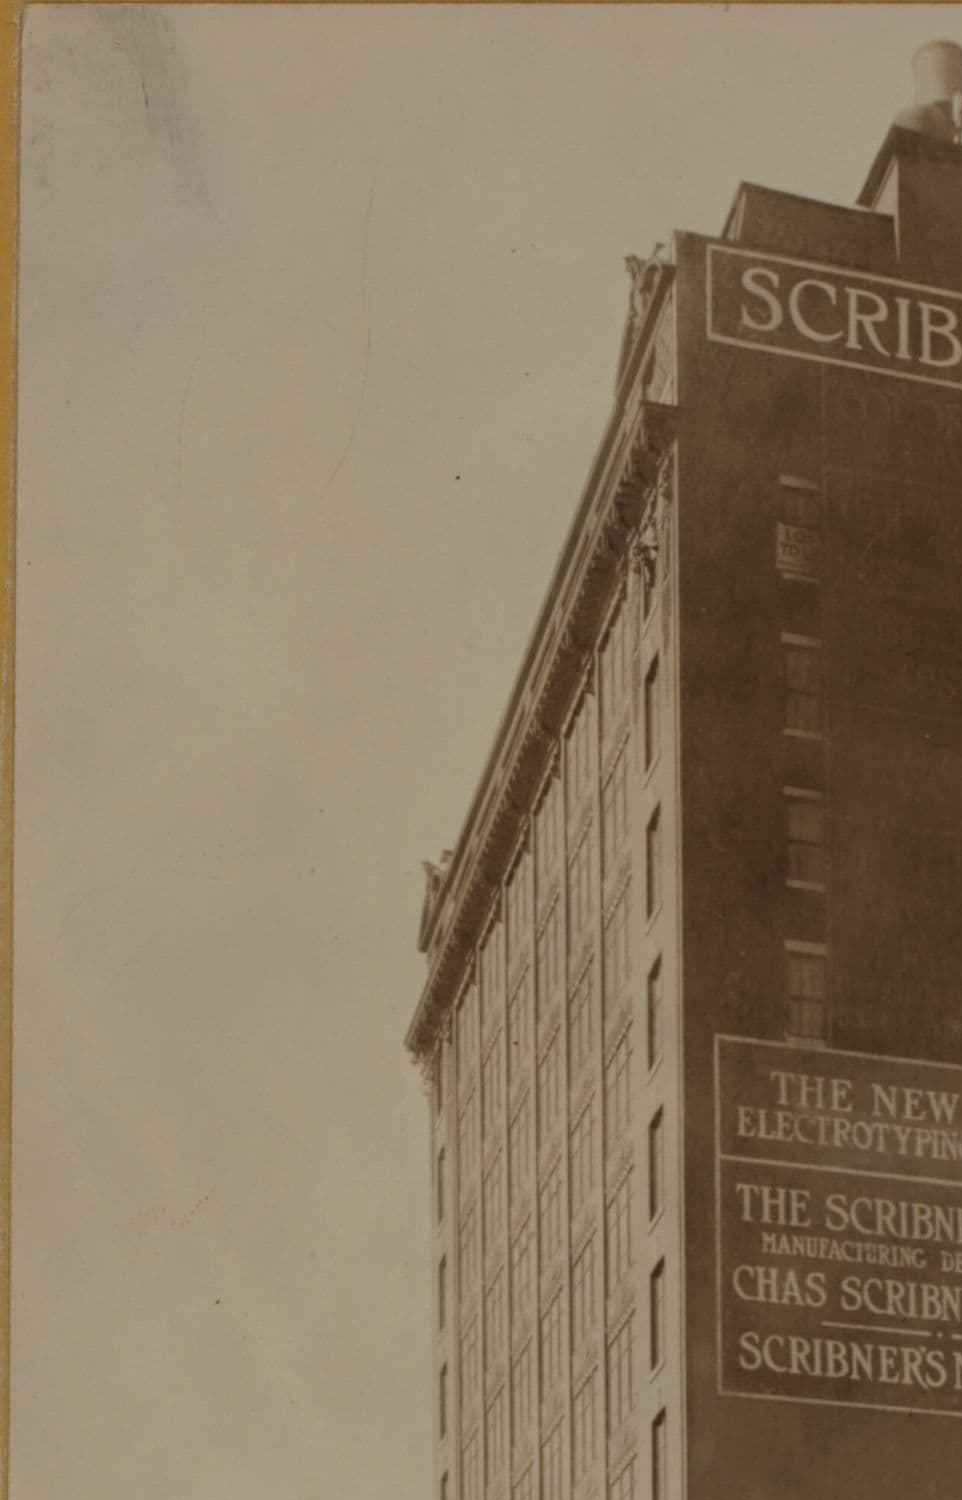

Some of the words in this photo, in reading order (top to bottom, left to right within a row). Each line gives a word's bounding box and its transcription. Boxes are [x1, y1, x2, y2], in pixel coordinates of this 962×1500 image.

[770, 1071, 853, 1112] THE
[871, 1084, 959, 1126] NEW
[736, 1184, 810, 1228] THE
[761, 1231, 927, 1270] MANUFACTURING
[732, 1265, 827, 1308] CHAS
